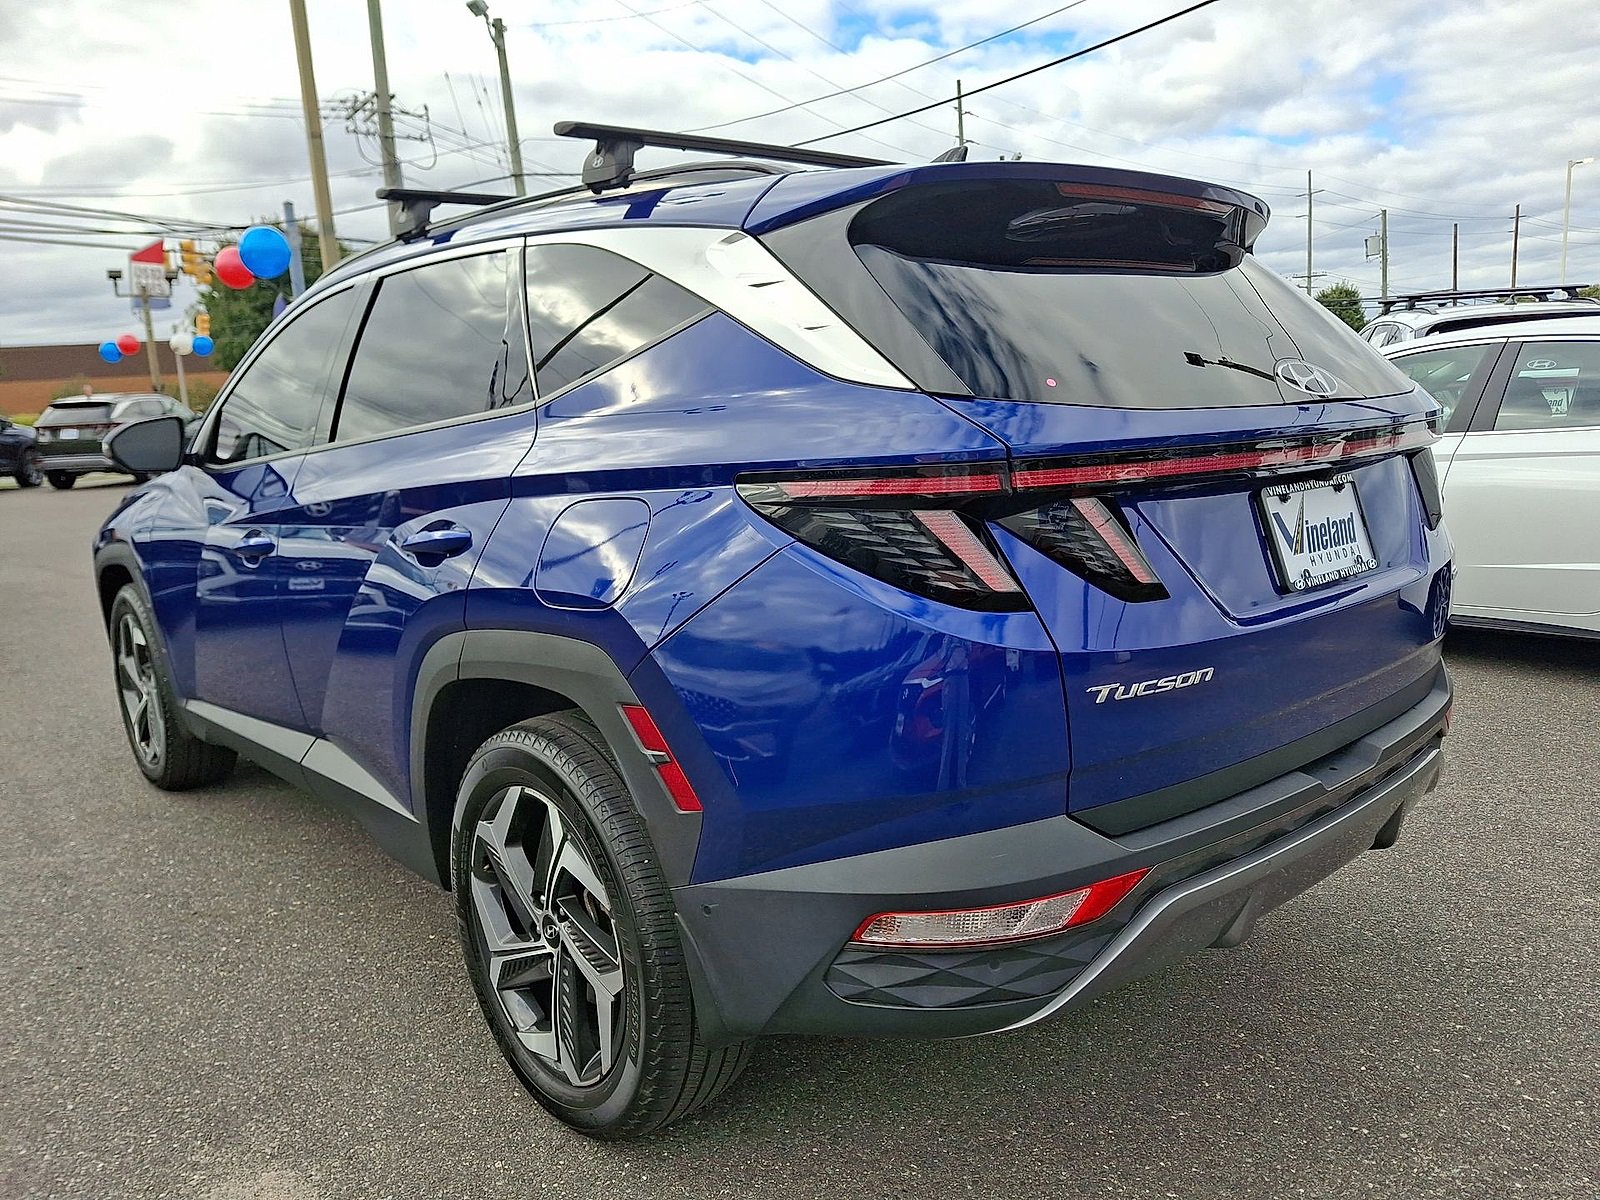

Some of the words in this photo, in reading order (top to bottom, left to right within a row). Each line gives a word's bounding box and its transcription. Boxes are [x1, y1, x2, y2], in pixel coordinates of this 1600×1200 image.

[1272, 491, 1357, 556] Vineland
[1310, 544, 1362, 567] HYUNDAI
[1305, 570, 1339, 588] VINELAND
[1340, 561, 1369, 579] HYUNDAI
